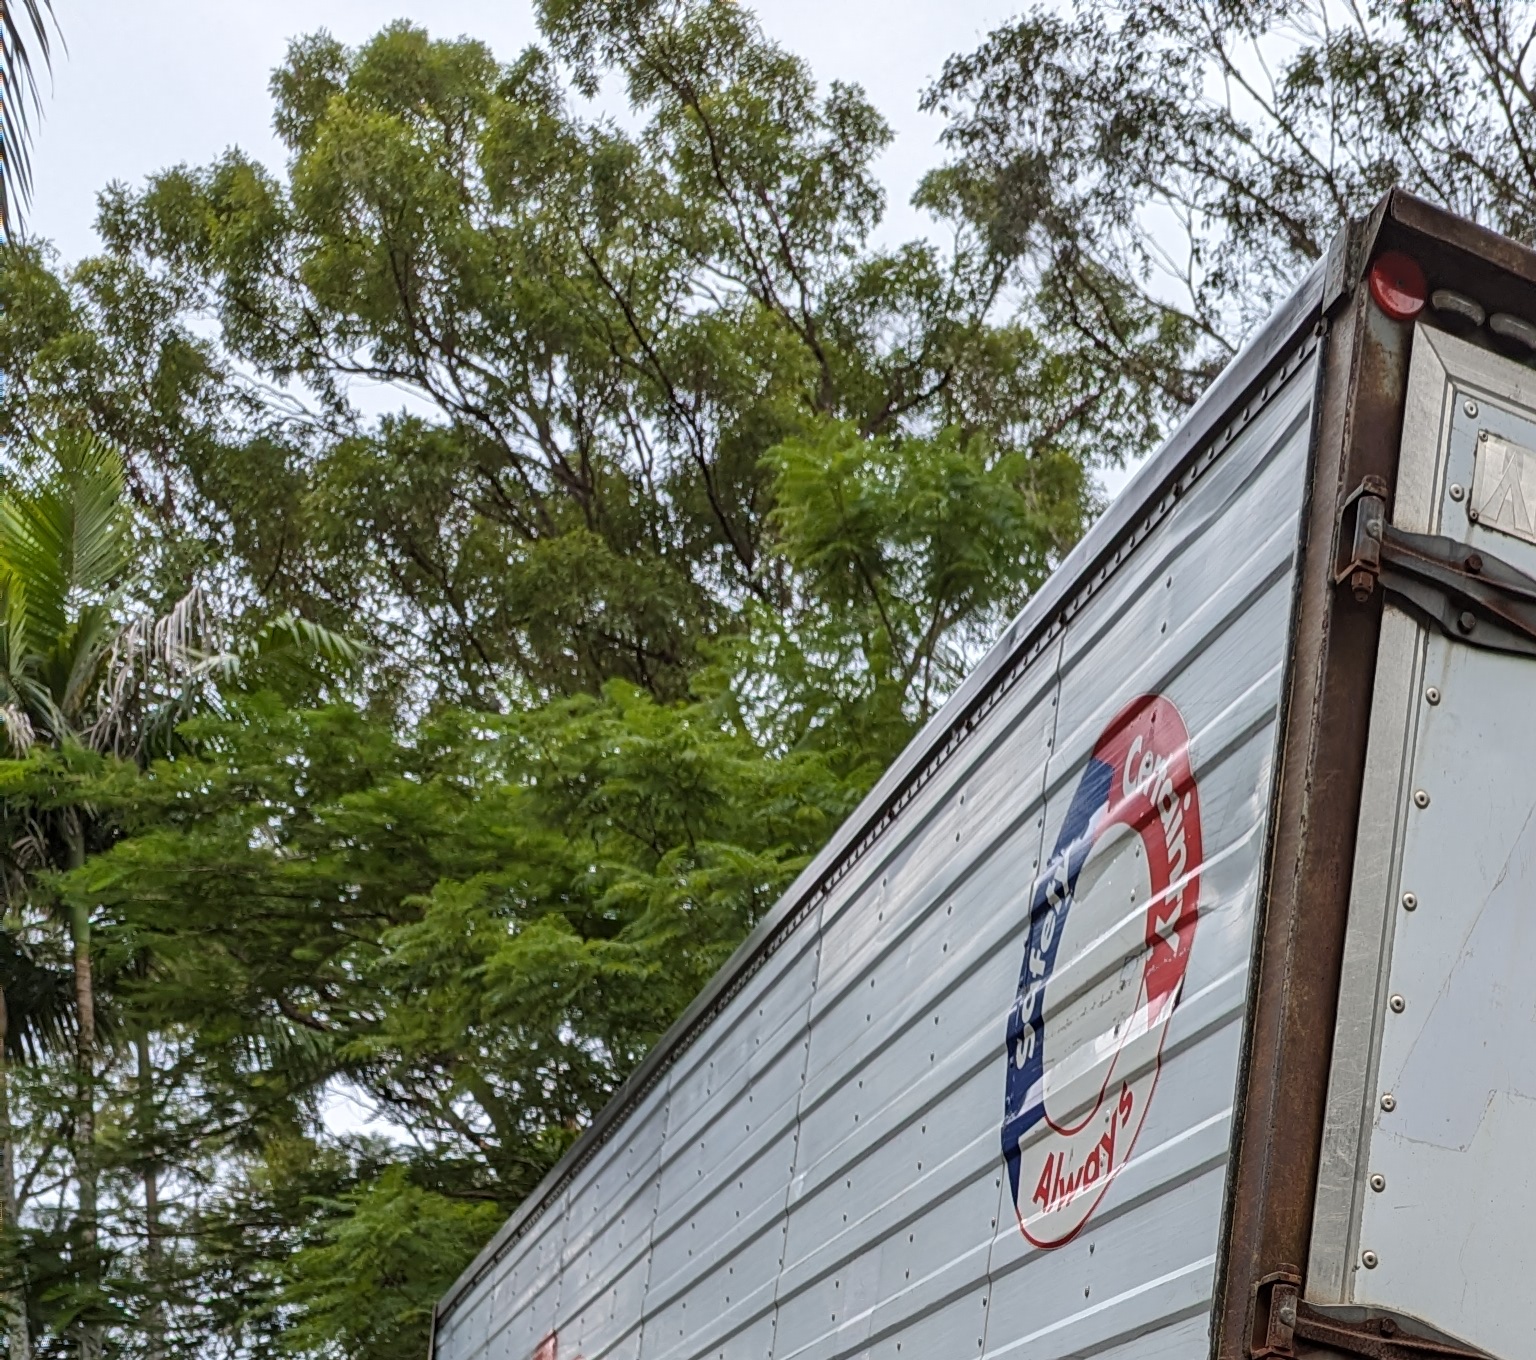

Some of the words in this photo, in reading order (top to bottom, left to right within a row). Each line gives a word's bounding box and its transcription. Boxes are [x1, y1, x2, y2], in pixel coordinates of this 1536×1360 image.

[1015, 838, 1076, 1071] Safety
[1123, 735, 1192, 958] Certainty
[1033, 1081, 1134, 1213] Always
